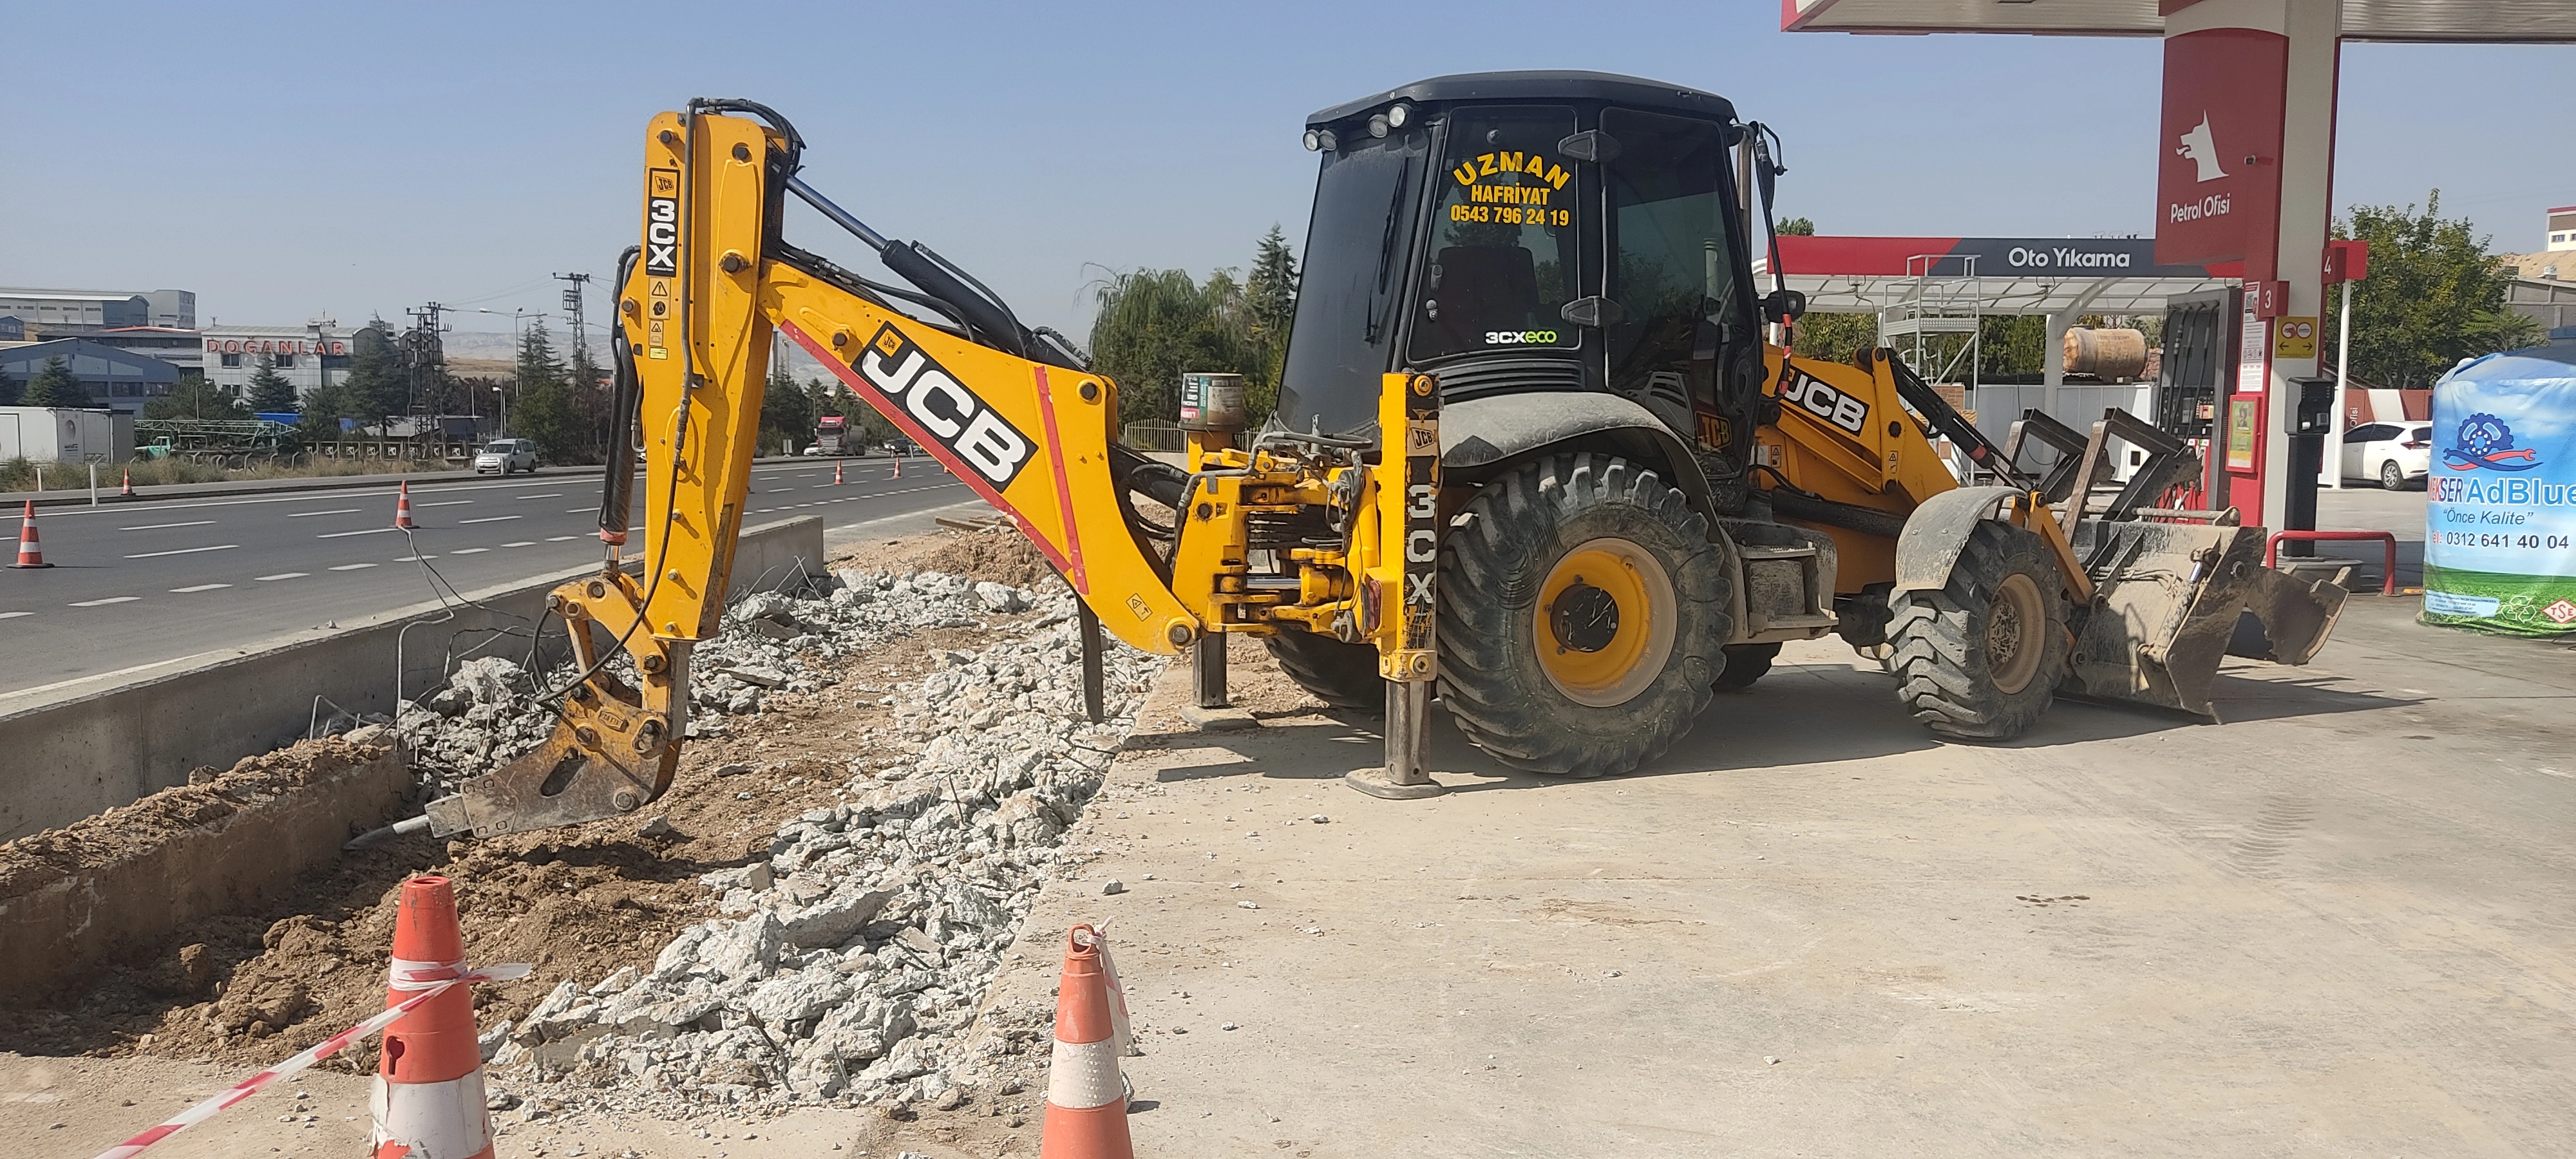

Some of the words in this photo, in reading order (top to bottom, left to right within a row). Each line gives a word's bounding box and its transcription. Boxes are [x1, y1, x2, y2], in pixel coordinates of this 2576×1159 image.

[1454, 151, 1571, 191] UZMAN
[658, 178, 674, 191] JCB
[1471, 182, 1551, 205] HAFRİYAT
[1451, 205, 1489, 222] 0543
[1493, 207, 1522, 224] 796
[1526, 208, 1546, 225] 24
[1550, 209, 1569, 226] 19
[2170, 198, 2202, 223] Petrol
[2204, 193, 2230, 217] Ofisi
[647, 200, 676, 267] 3CX
[2008, 247, 2049, 267] Oto
[2052, 247, 2130, 267] Yıkama
[2324, 256, 2332, 274] 4
[2264, 290, 2271, 309] 3
[207, 335, 345, 355] DOĞANLAR
[883, 335, 896, 349] JCB
[1784, 373, 1865, 432] JCB
[862, 350, 1027, 482] JCB
[2349, 407, 2358, 428] Ofisi
[1415, 429, 1434, 446] JCB
[1699, 416, 1731, 449] JCB
[2447, 531, 2476, 546] 0312
[2481, 533, 2509, 547] 641
[2517, 534, 2539, 549] 40
[2547, 535, 2569, 549] 04
[2551, 604, 2573, 619] TSE
